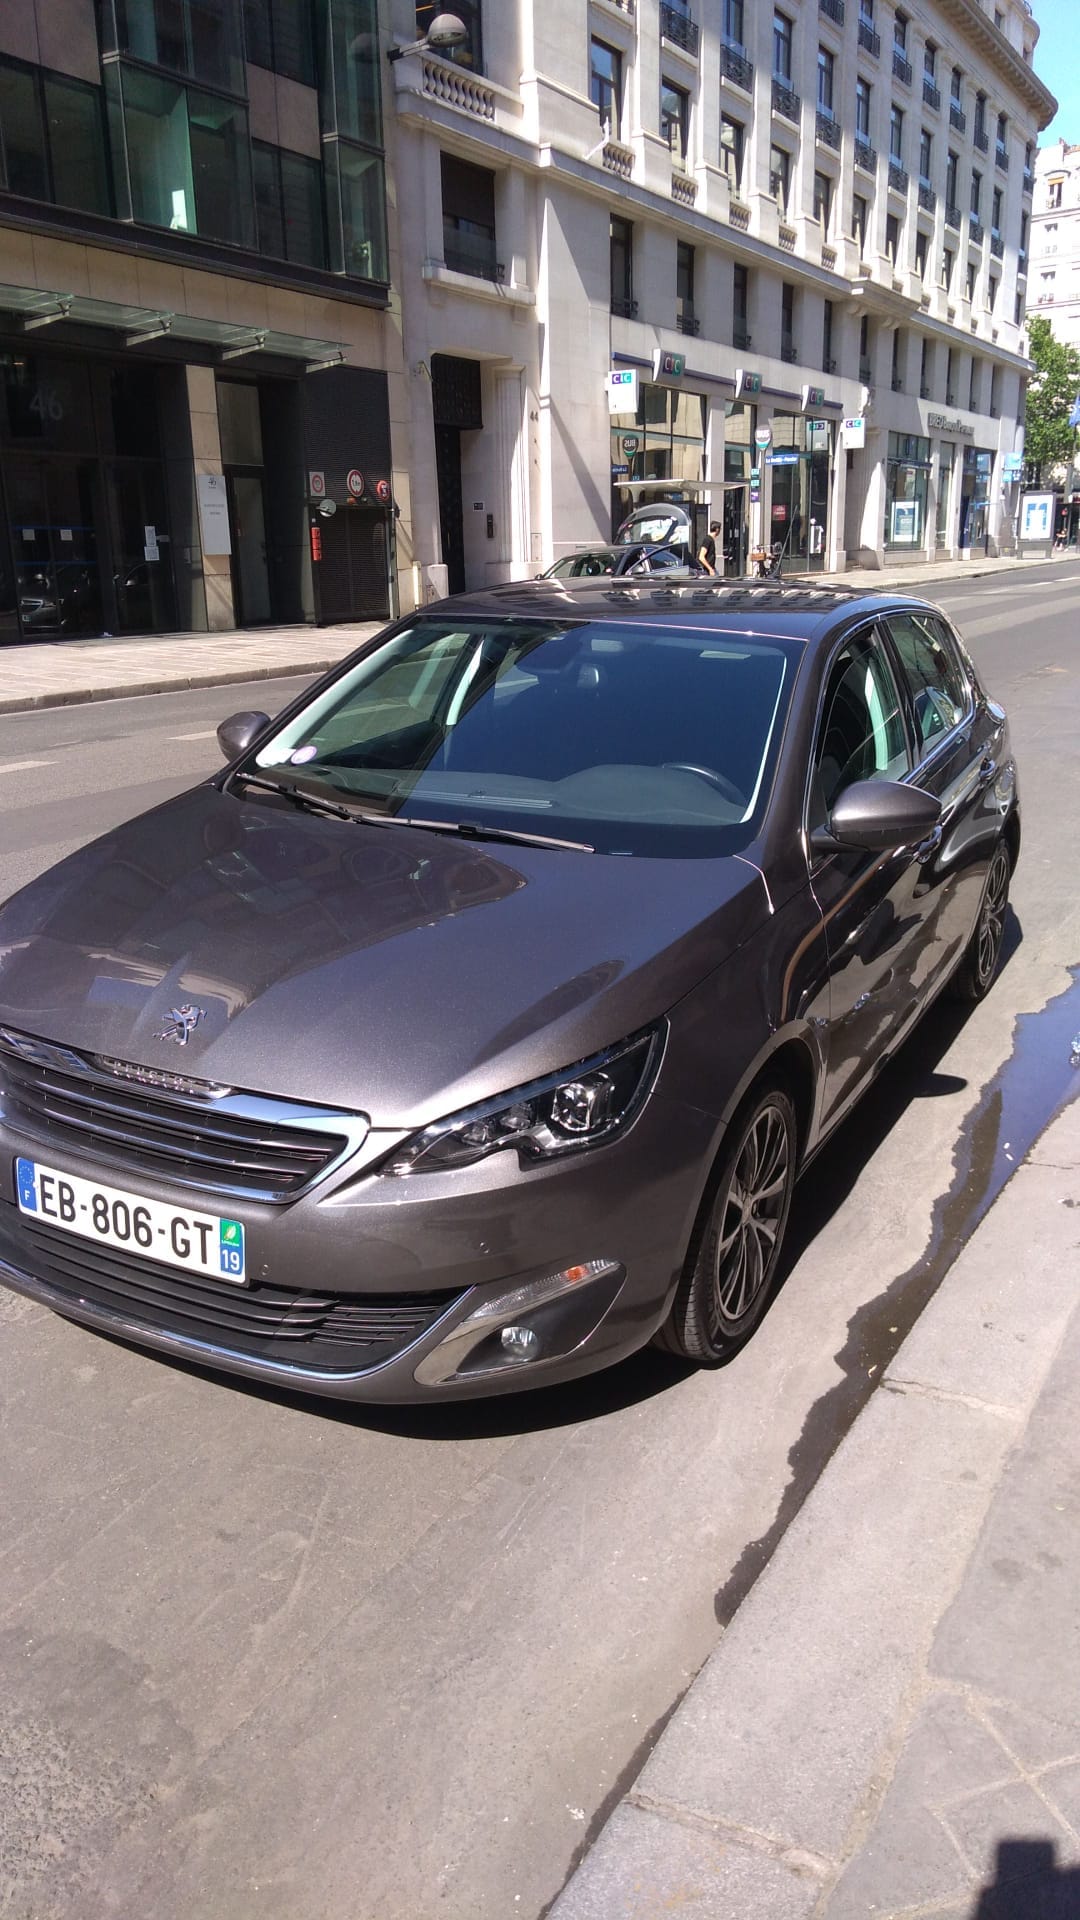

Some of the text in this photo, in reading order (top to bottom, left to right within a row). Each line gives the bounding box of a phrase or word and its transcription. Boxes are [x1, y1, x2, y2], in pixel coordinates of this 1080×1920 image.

[665, 357, 681, 373] CIC
[613, 373, 632, 384] CIC
[746, 375, 759, 390] CIC
[29, 388, 63, 421] 46
[810, 391, 824, 405] CIC
[846, 420, 861, 428] CIC
[756, 429, 770, 437] BUS
[25, 1190, 31, 1201] F
[40, 1173, 214, 1265] EB-806-GT
[222, 1249, 240, 1271] 19
